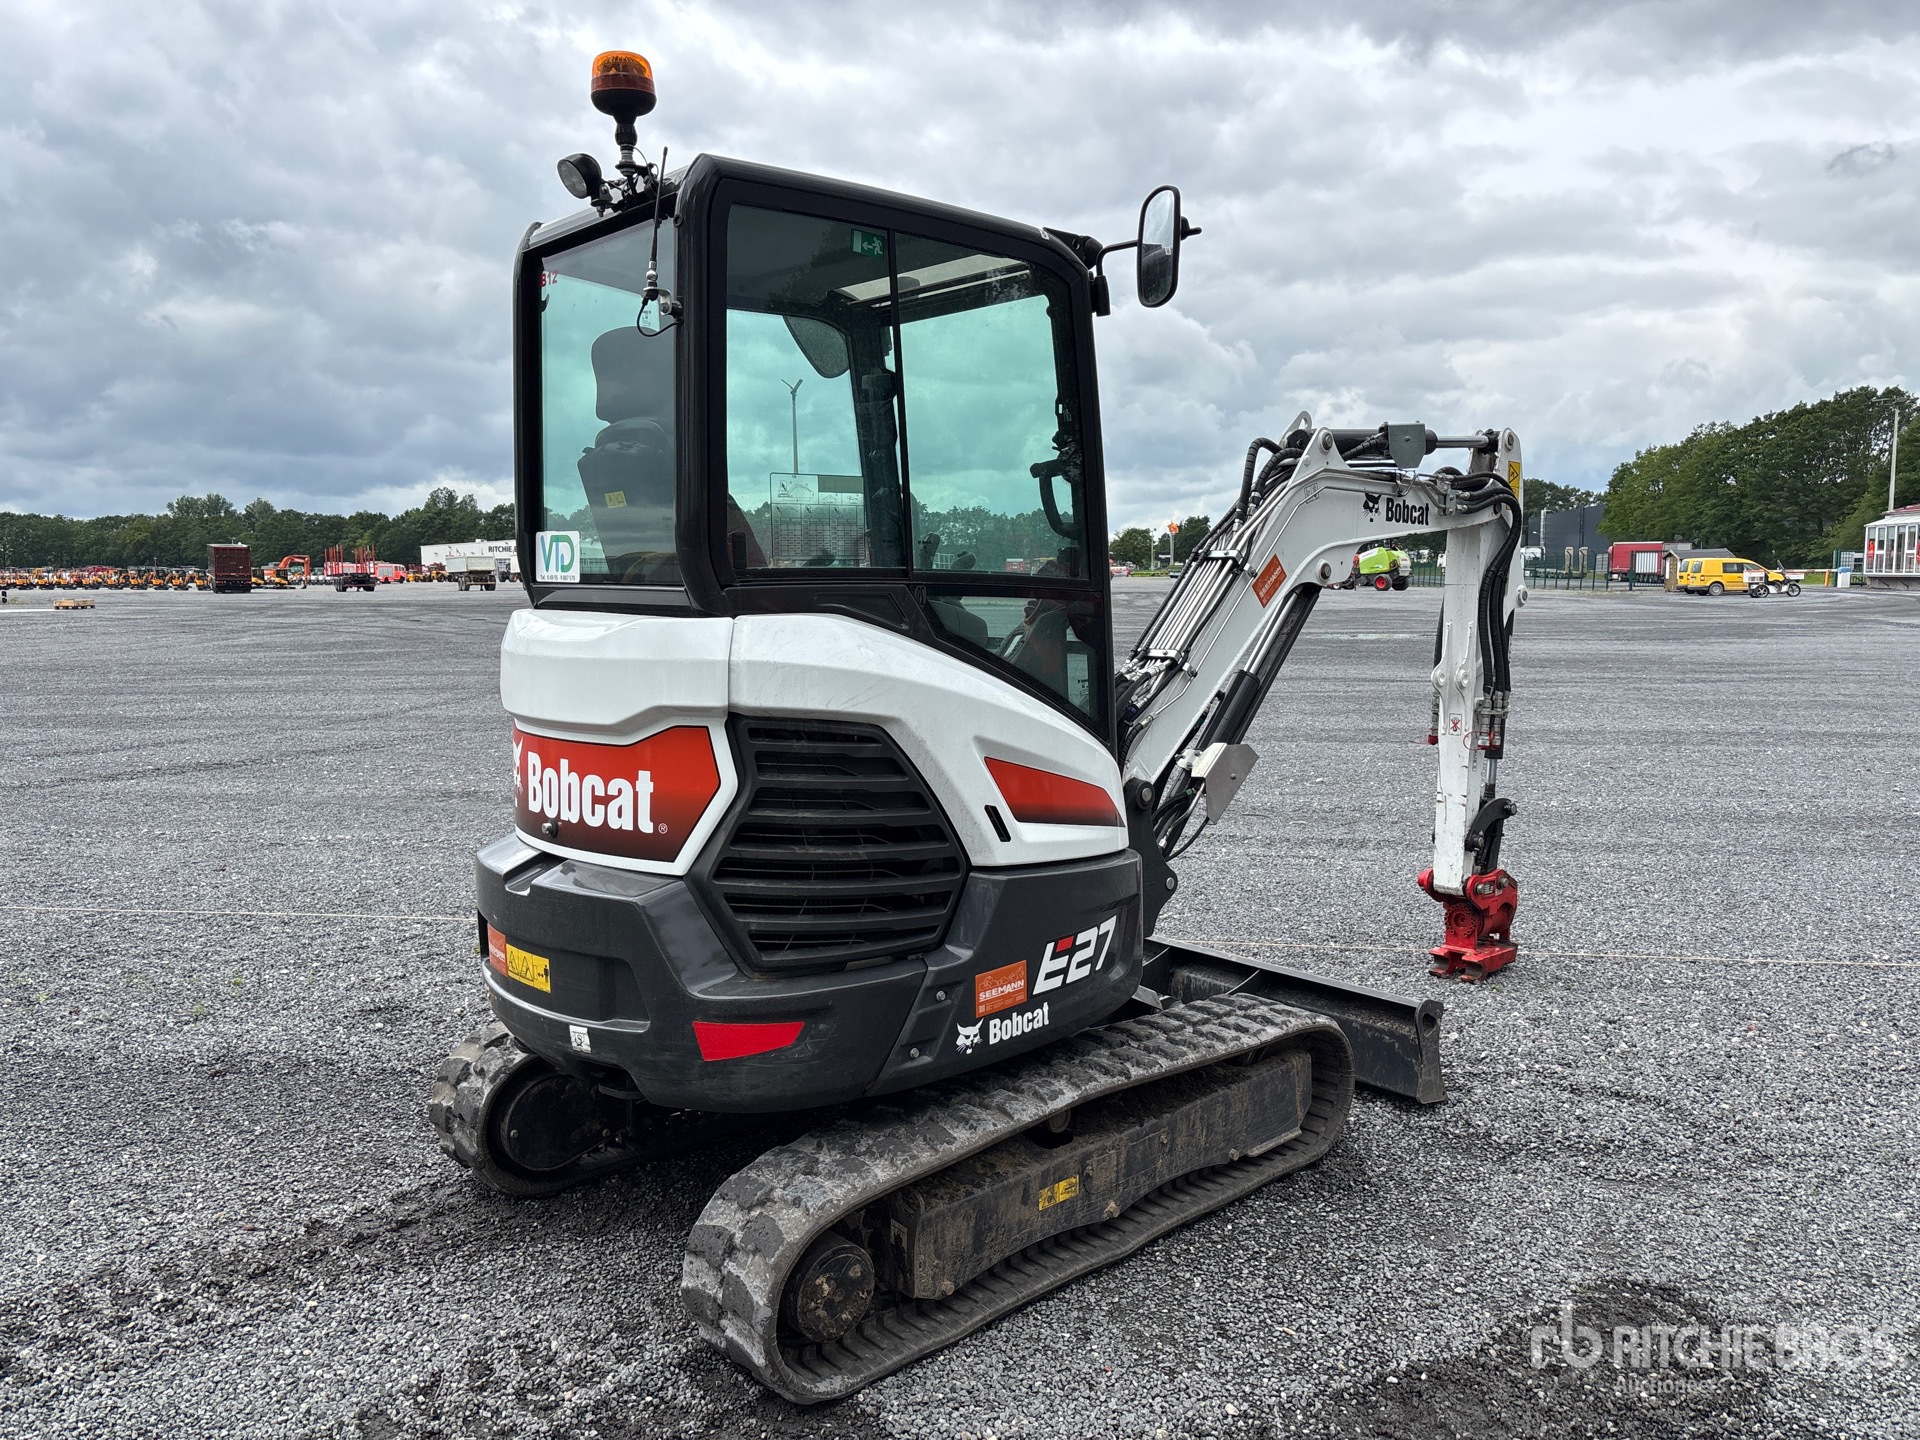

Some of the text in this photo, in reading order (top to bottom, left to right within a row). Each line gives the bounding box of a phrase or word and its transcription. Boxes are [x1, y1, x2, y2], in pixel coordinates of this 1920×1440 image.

[1386, 497, 1430, 526] Bobcat
[488, 545, 512, 553] RITCHIE
[528, 751, 654, 833] Bobcat
[1032, 915, 1117, 996] E27
[978, 979, 1025, 1000] SEEMANN
[989, 1002, 1050, 1045] Bobcat
